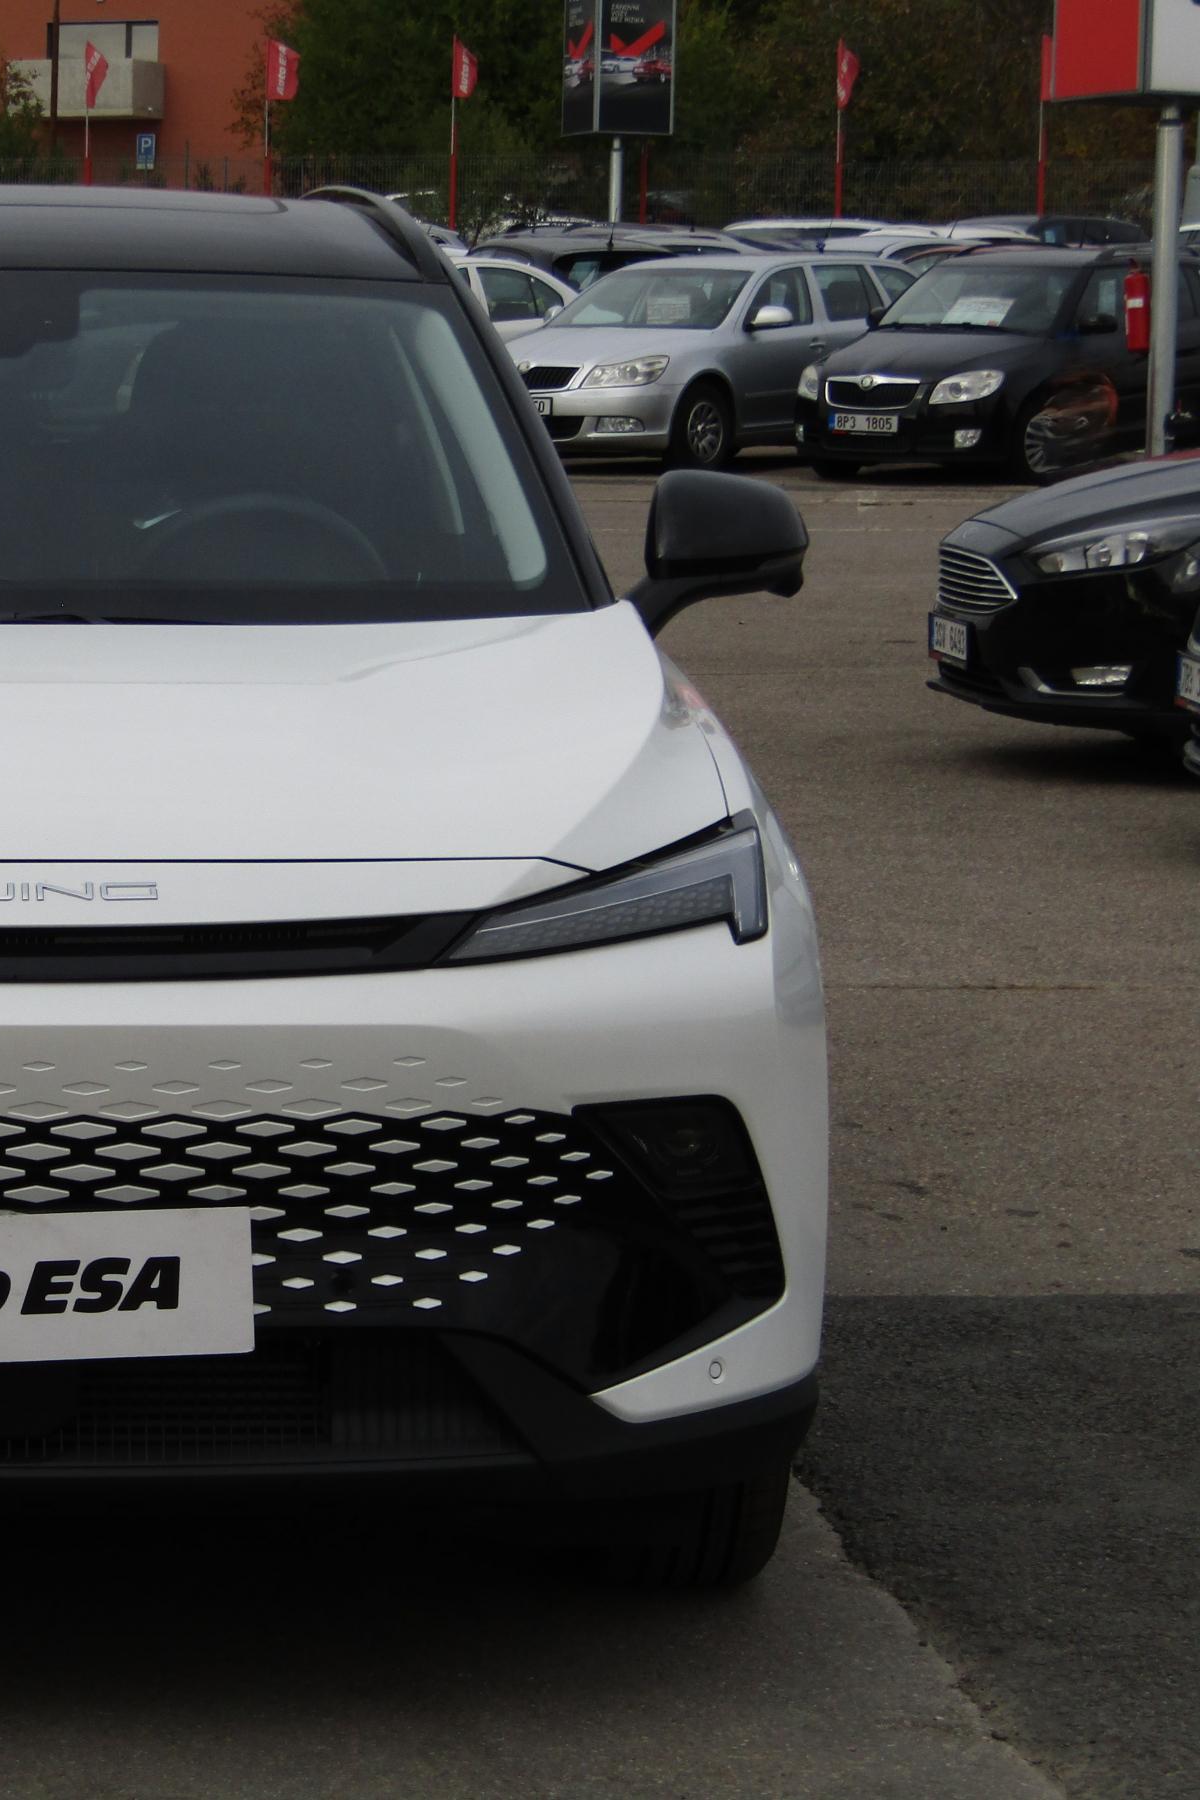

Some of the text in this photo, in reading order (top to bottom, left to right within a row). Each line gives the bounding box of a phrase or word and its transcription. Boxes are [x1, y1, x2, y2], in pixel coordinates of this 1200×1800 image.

[141, 137, 151, 153] P
[836, 416, 892, 430] 8P3 1805
[20, 1255, 181, 1315] ESA
